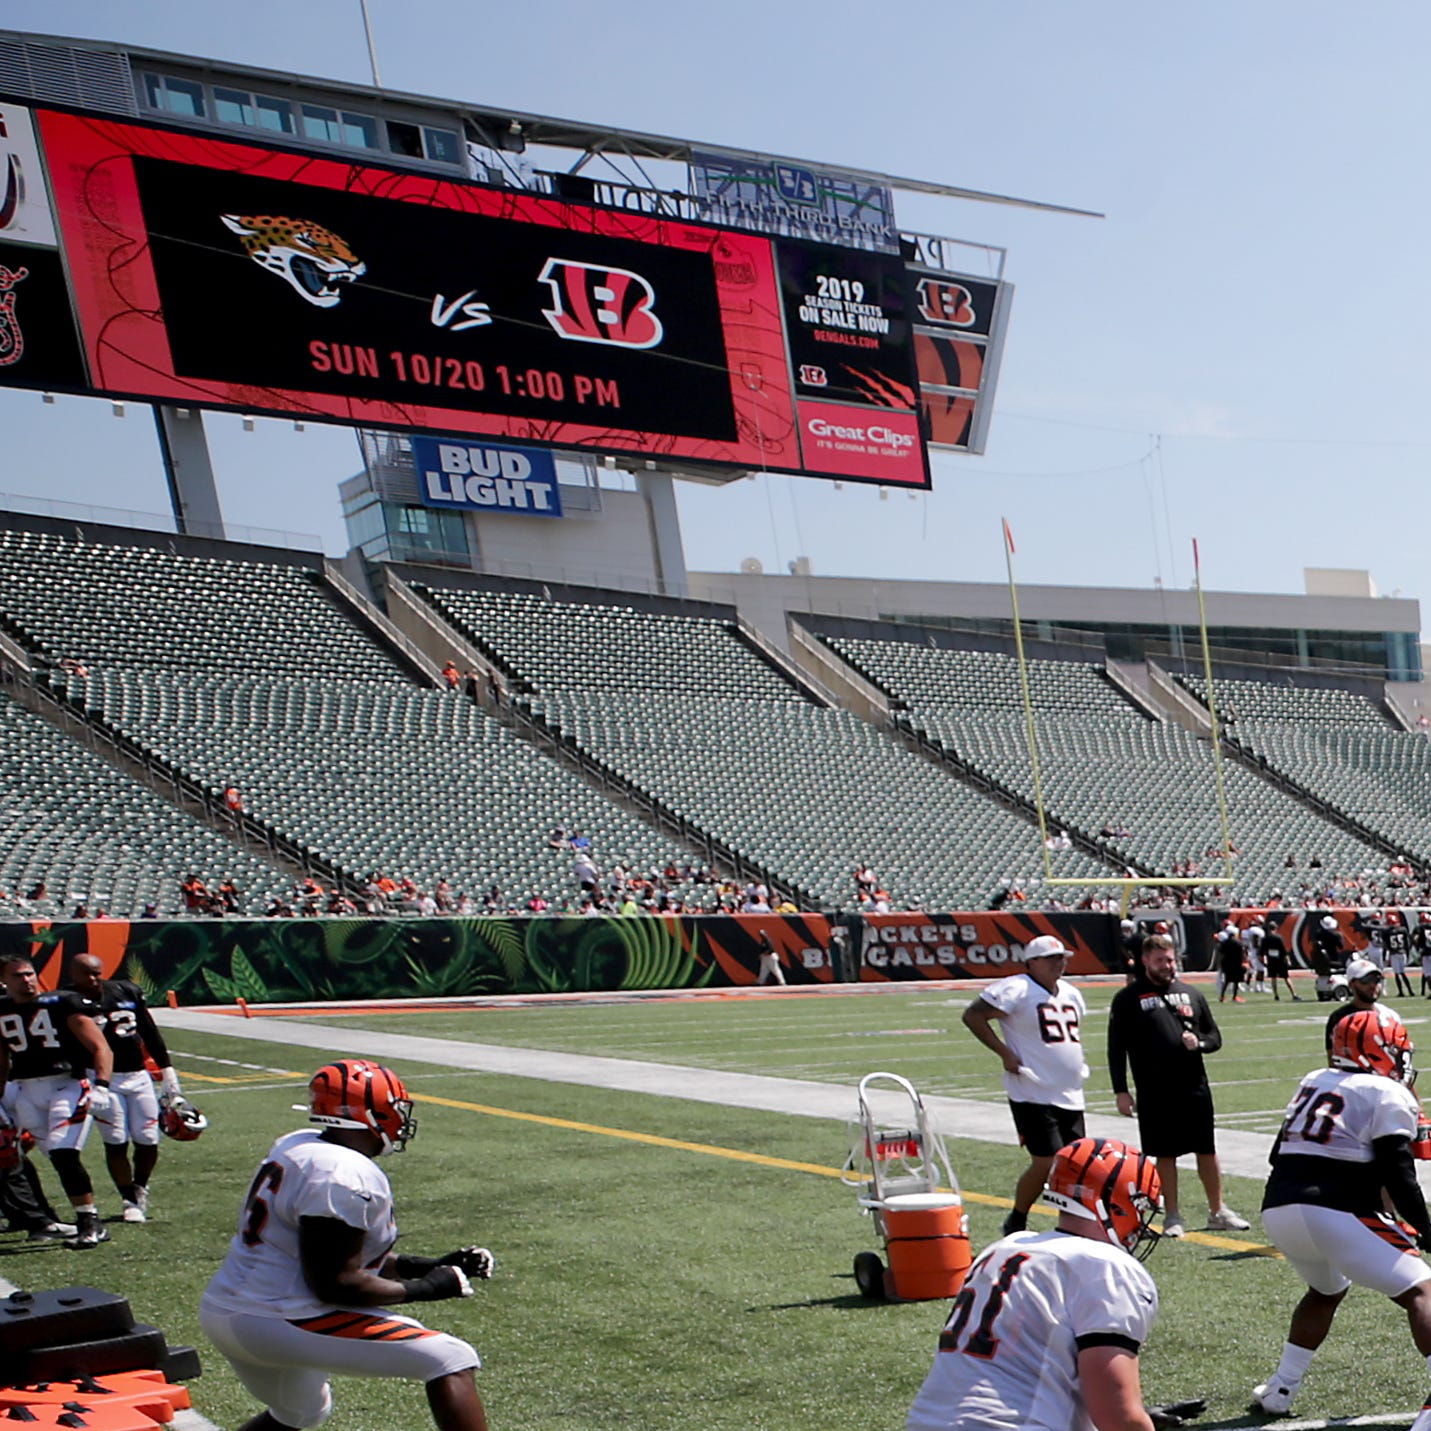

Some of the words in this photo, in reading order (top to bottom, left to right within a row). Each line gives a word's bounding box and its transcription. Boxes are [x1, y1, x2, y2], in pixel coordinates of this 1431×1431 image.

[770, 202, 833, 227] THIRD
[838, 214, 892, 238] BANK
[804, 294, 842, 311] SEASON
[843, 301, 883, 317] TICKETS
[815, 274, 865, 303] 2019
[798, 305, 820, 325] ON
[821, 309, 857, 330] SALE
[859, 315, 890, 335] NOW
[309, 340, 380, 379] SUN
[390, 351, 486, 392] 10/20
[495, 364, 566, 402] 1:00
[573, 374, 622, 408] PM
[808, 418, 866, 441] Great
[867, 426, 913, 448] Clips
[439, 443, 532, 480] BUD
[425, 471, 552, 511] LIGHT
[831, 924, 978, 943] TCKETS
[0, 1008, 61, 1053] 94
[1037, 1003, 1079, 1044] 62
